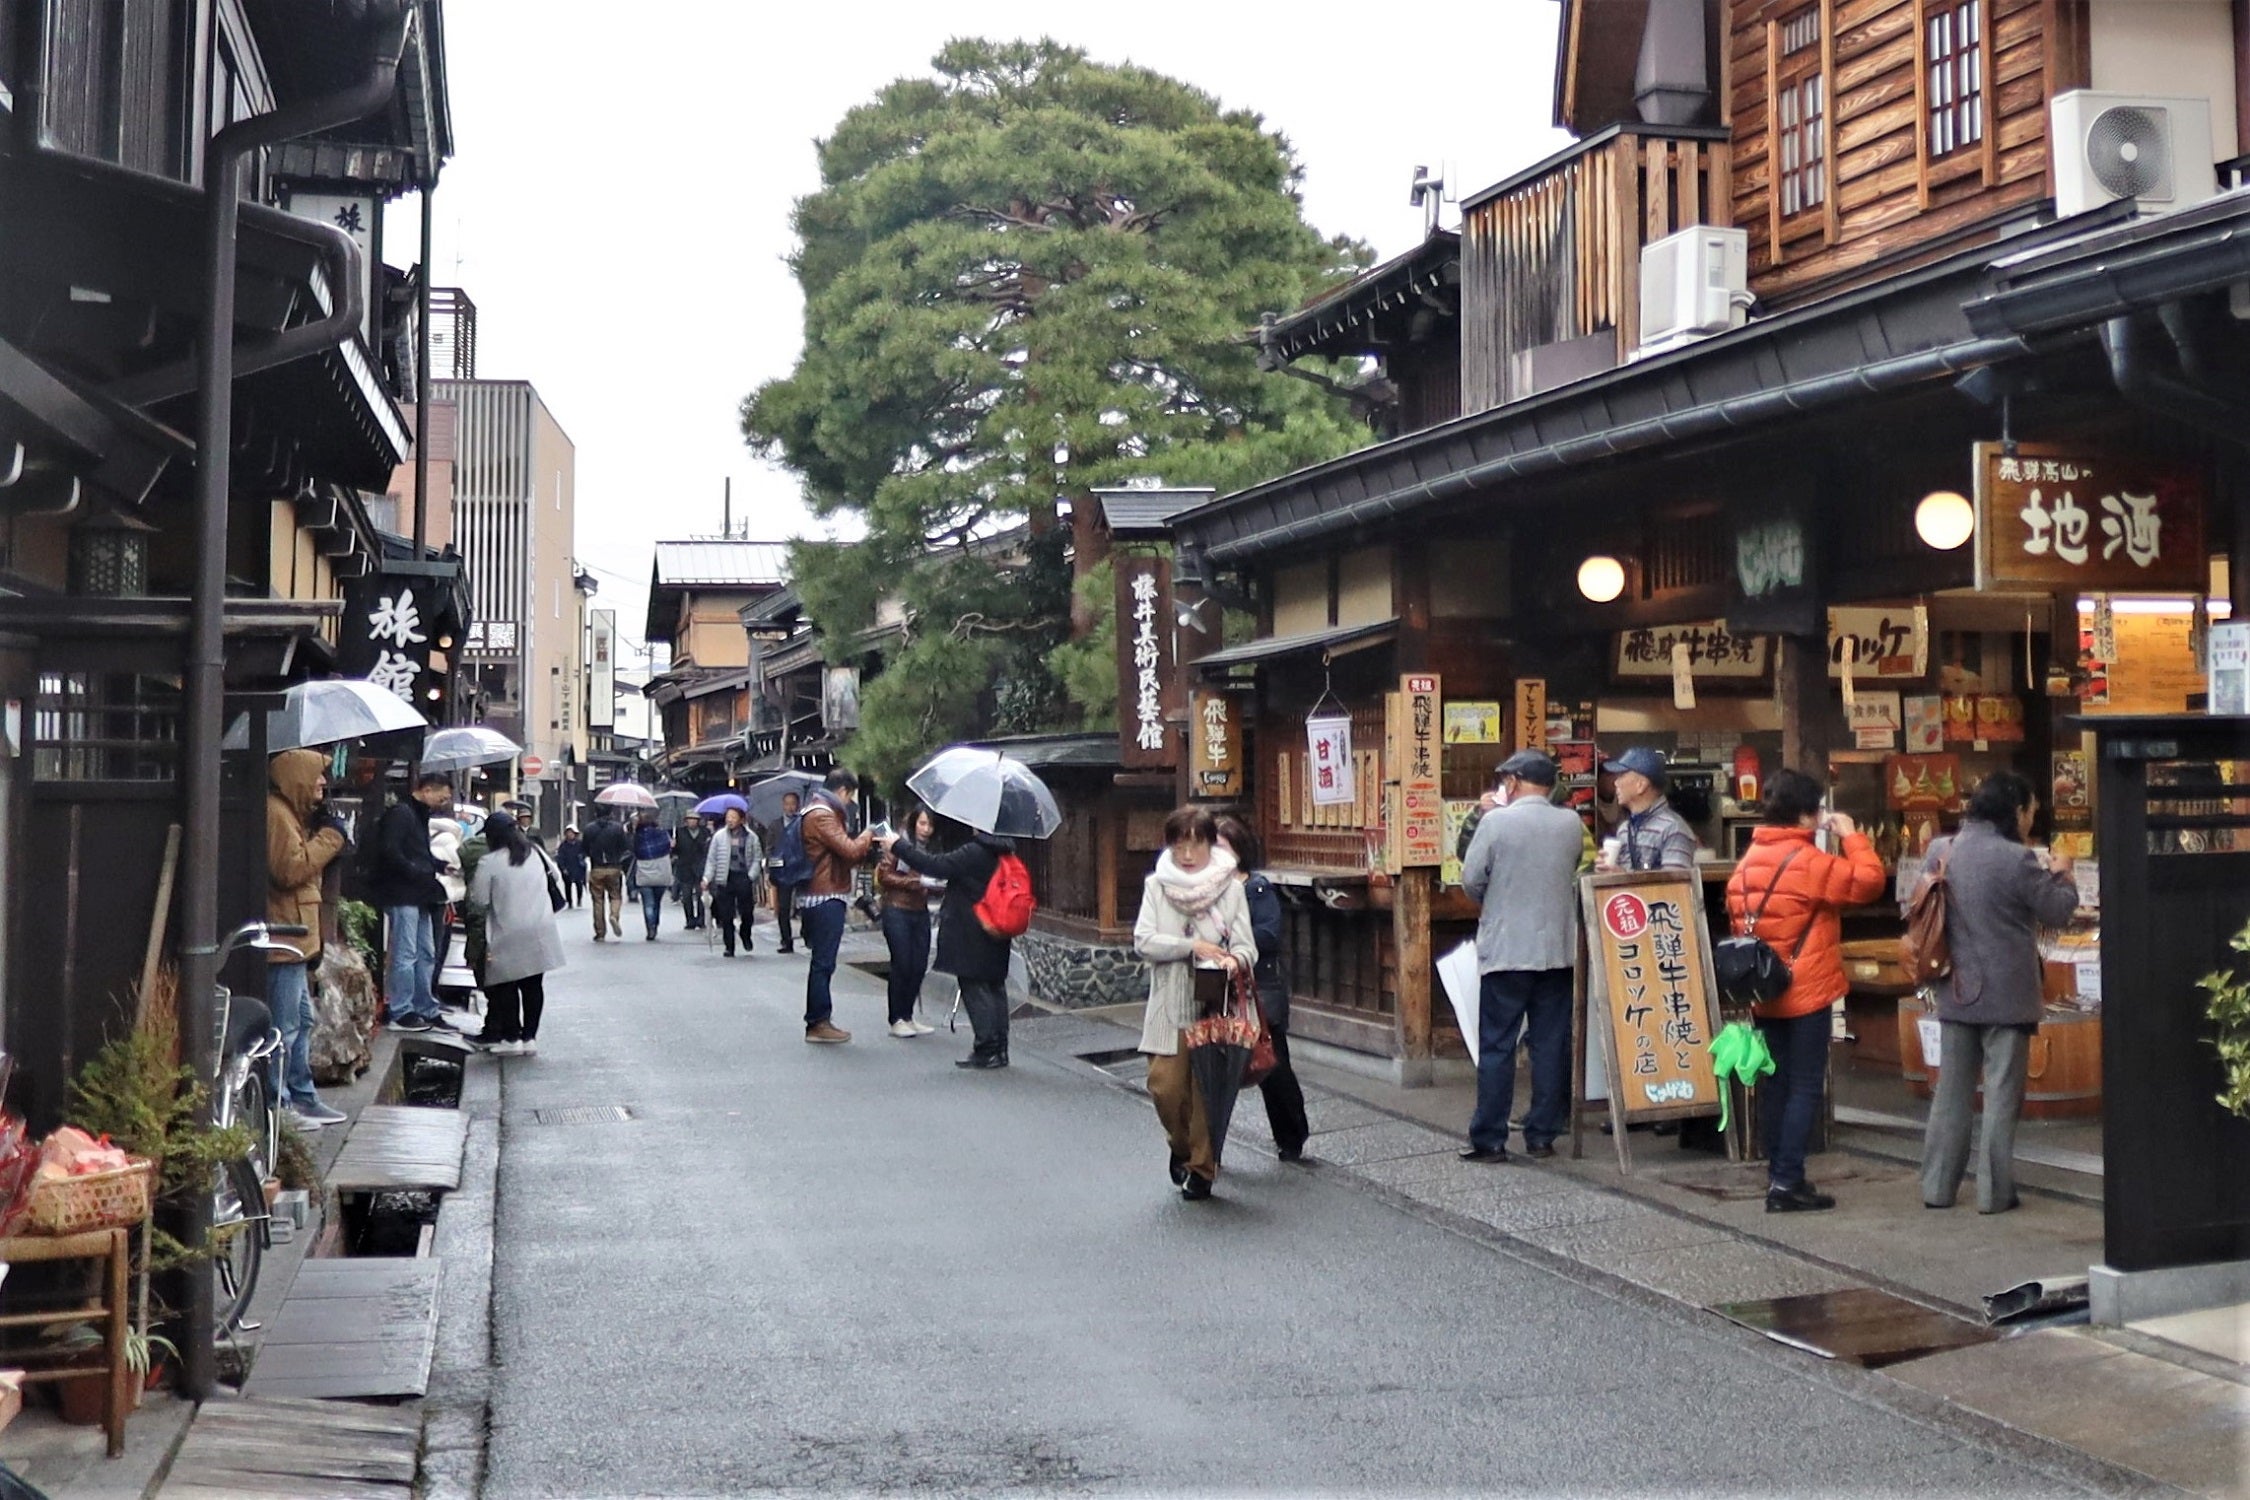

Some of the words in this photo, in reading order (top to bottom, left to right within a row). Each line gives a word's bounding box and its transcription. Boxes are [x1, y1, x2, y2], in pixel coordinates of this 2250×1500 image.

[2019, 488, 2162, 568] 地酒
[366, 587, 428, 702] 旅館
[1203, 698, 1228, 768] 飛騨牛
[1316, 737, 1334, 789] 甘酒
[1613, 898, 1641, 934] 元祖
[1617, 942, 1659, 1075] コロッケの店
[1648, 901, 1701, 1070] 飛騨牛串焼と
